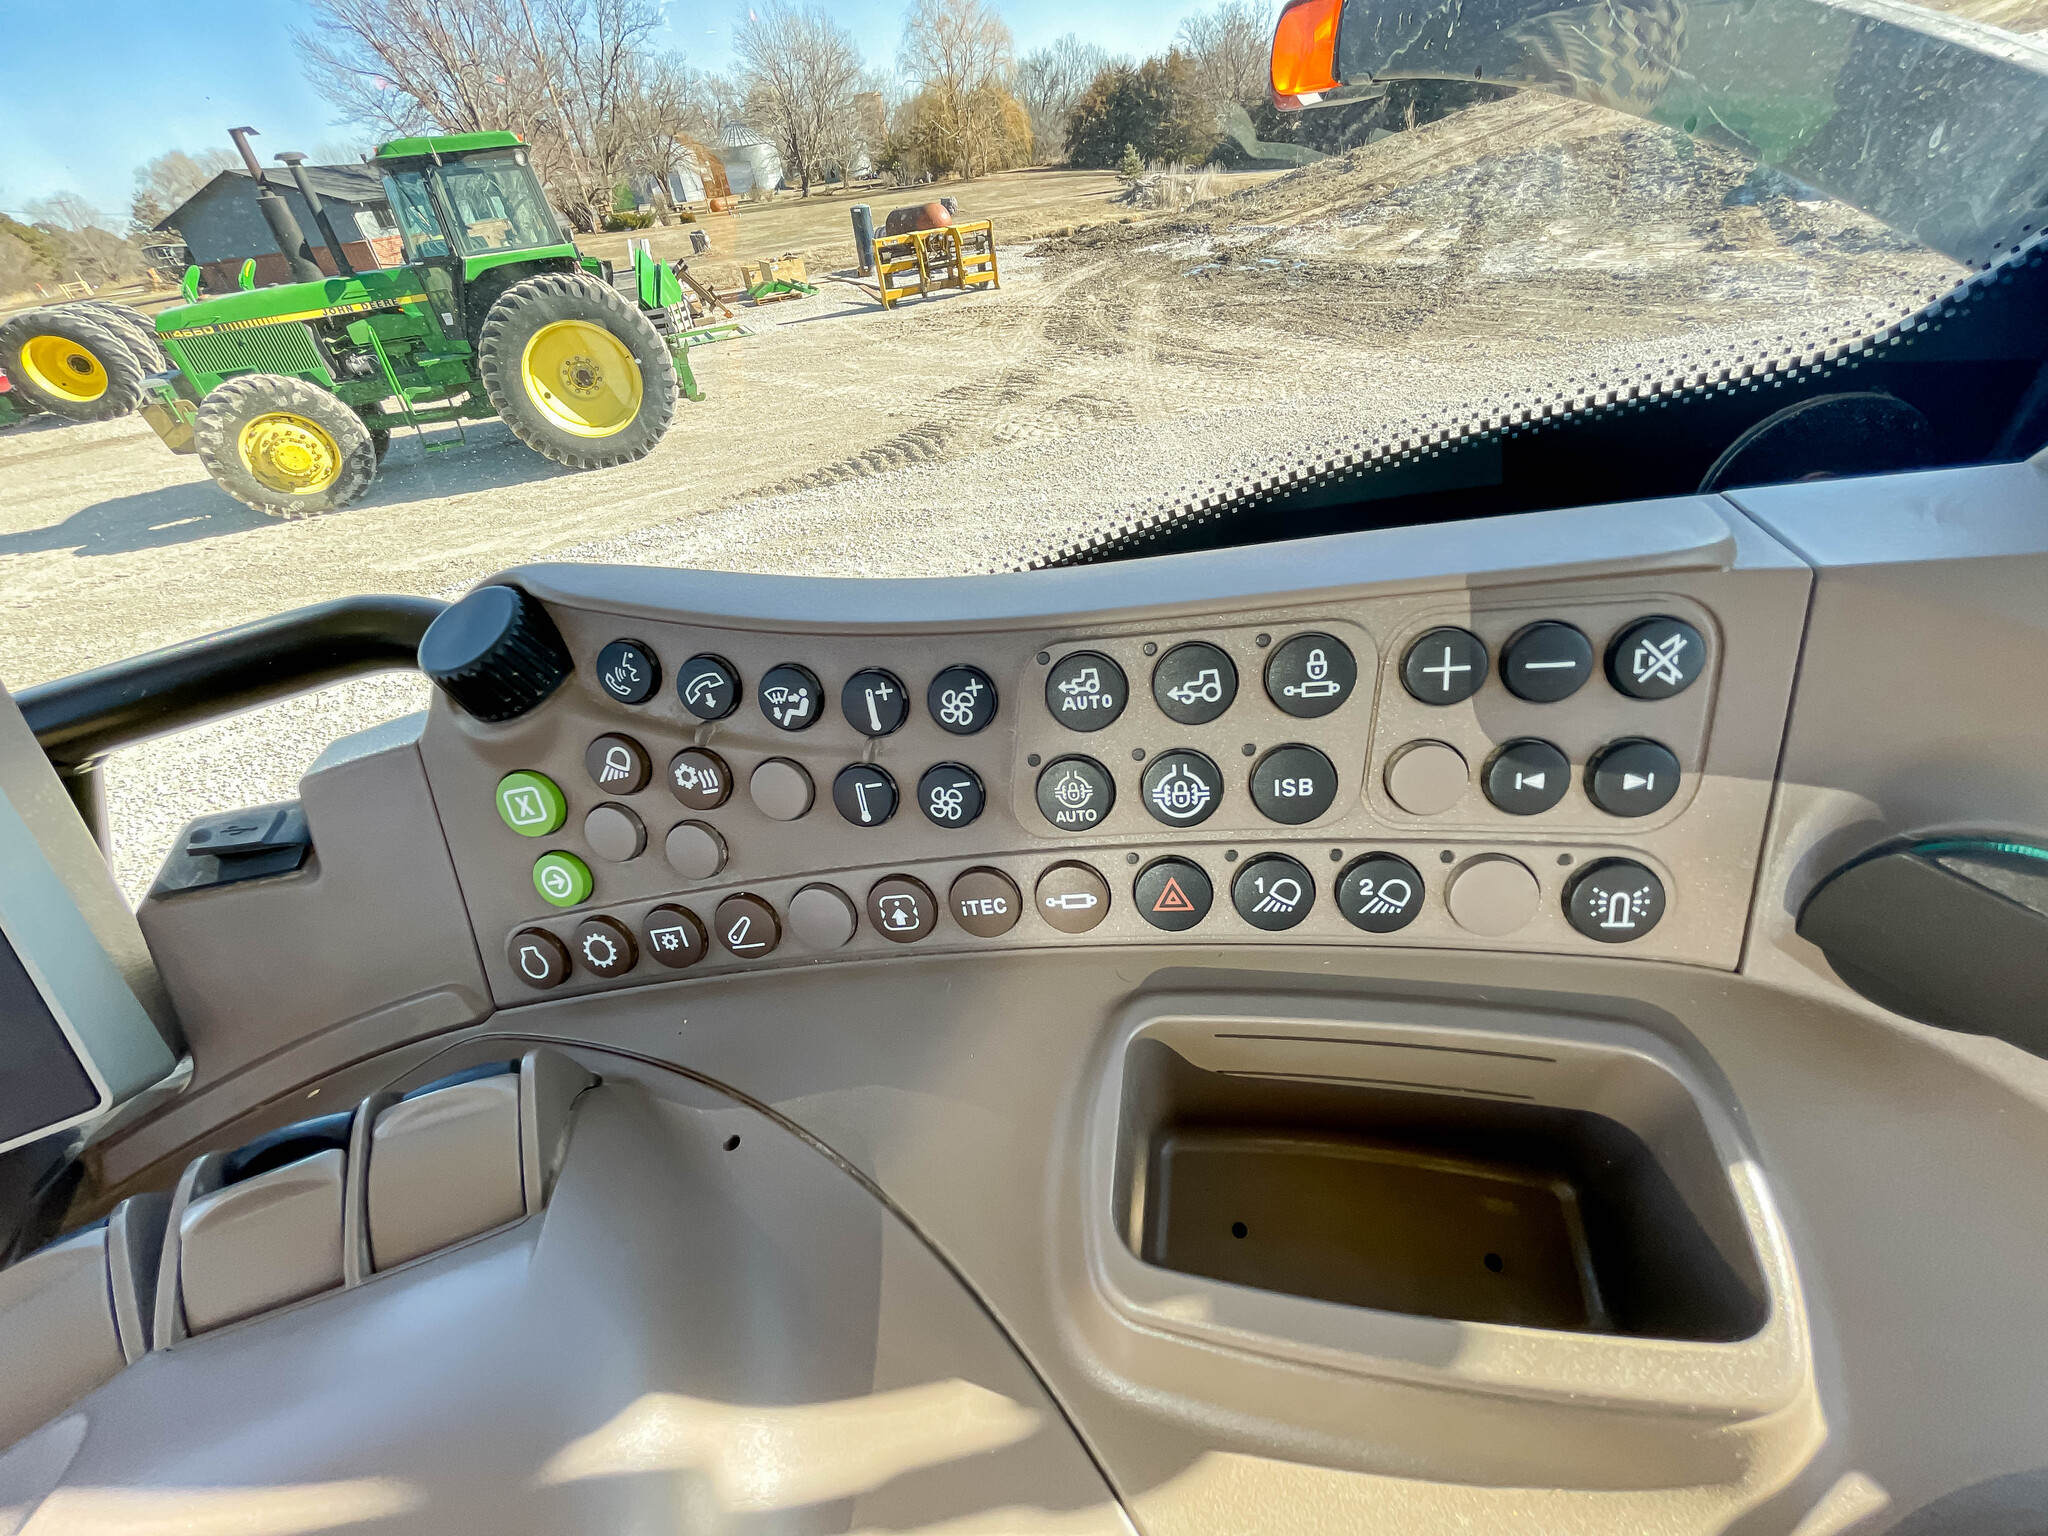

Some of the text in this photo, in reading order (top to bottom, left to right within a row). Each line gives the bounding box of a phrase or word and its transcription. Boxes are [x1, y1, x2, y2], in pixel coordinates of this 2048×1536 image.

[322, 298, 399, 317] JOHN DEERE
[1061, 693, 1114, 712] AUTO
[1274, 777, 1314, 797] ISB
[1055, 809, 1098, 823] AUTO
[1254, 877, 1264, 894] 1
[1359, 878, 1374, 896] 2
[961, 897, 1008, 917] iTEC
